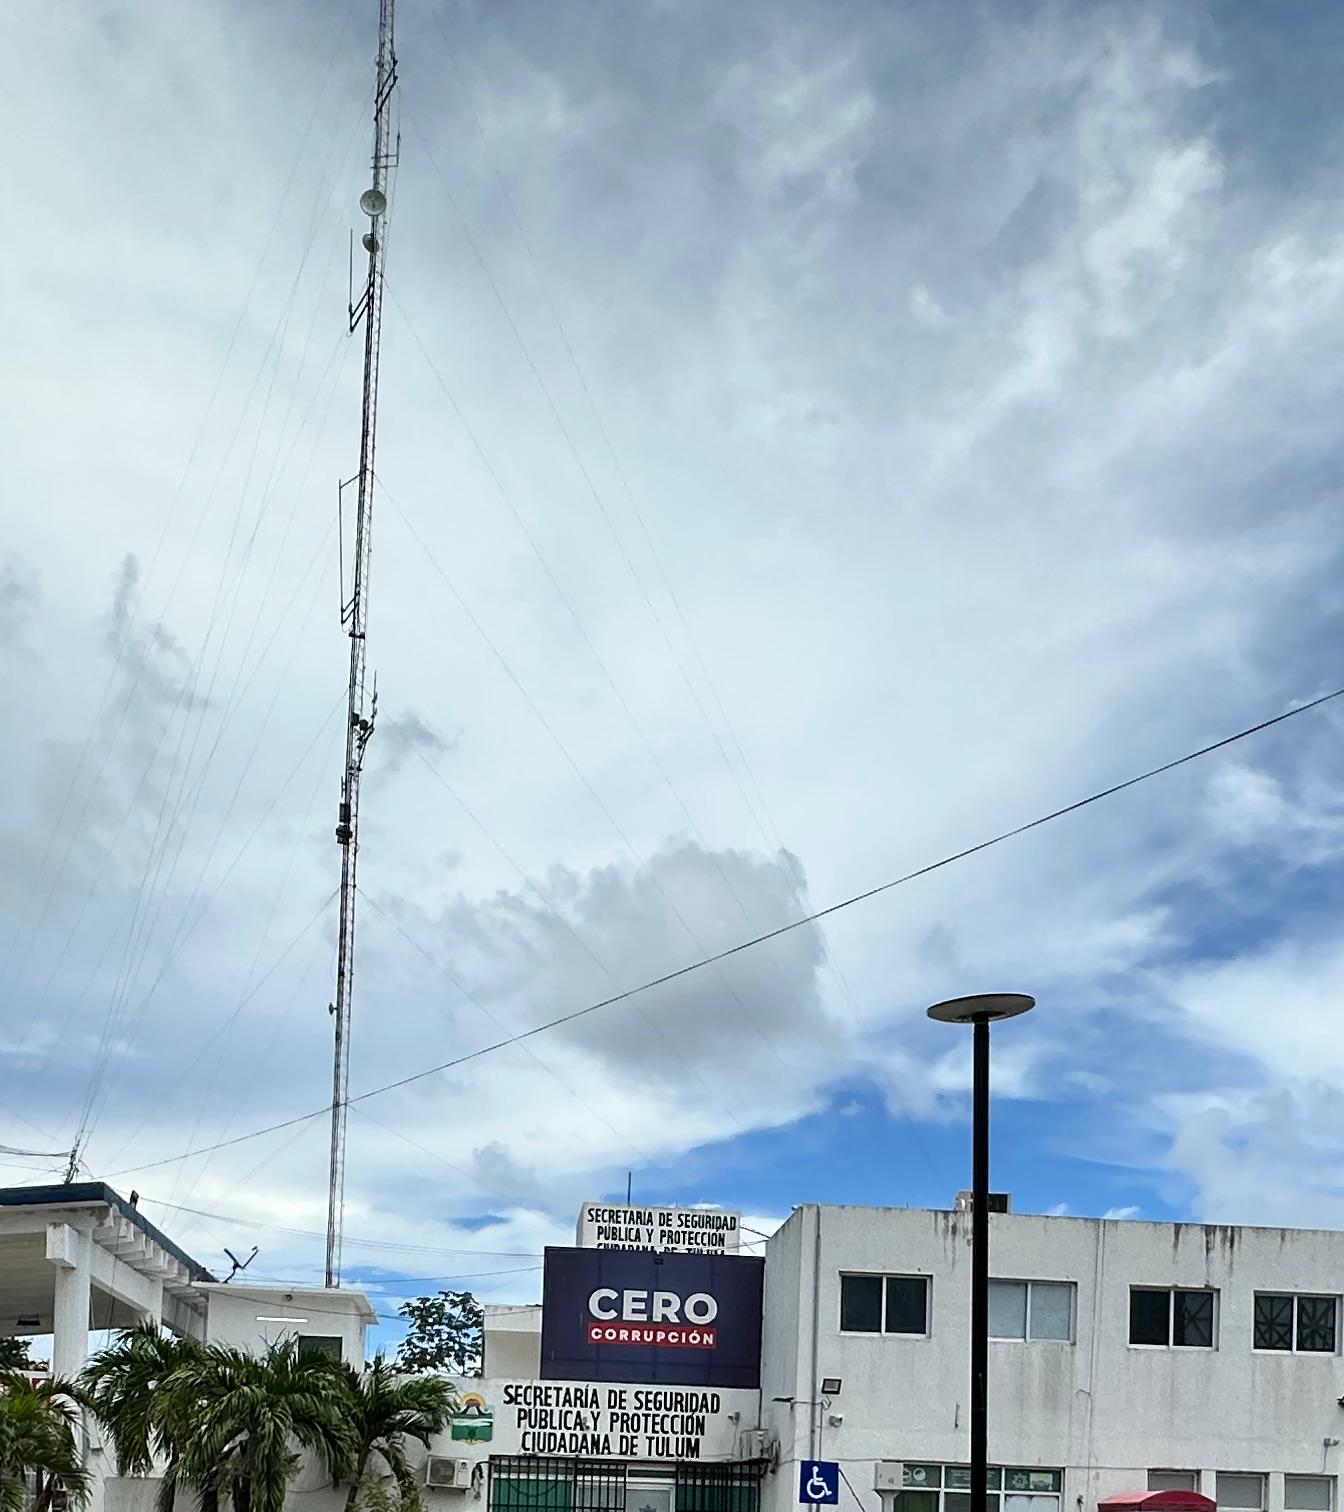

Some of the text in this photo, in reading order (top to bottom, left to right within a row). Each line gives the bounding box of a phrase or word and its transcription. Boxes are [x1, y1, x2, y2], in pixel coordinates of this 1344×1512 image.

[658, 1212, 673, 1227] DE
[677, 1213, 736, 1231] SEGURIDAD
[646, 1228, 654, 1243] Y
[588, 1288, 718, 1325] CERO
[591, 1327, 714, 1345] CORRUPCIÓN
[503, 1384, 721, 1414] SECRETARÍA DE SEGURIDAD
[590, 1410, 601, 1431] Y
[609, 1411, 706, 1436] PROTECCIÓN
[521, 1431, 701, 1458] CIUDADANA DE TULUM
